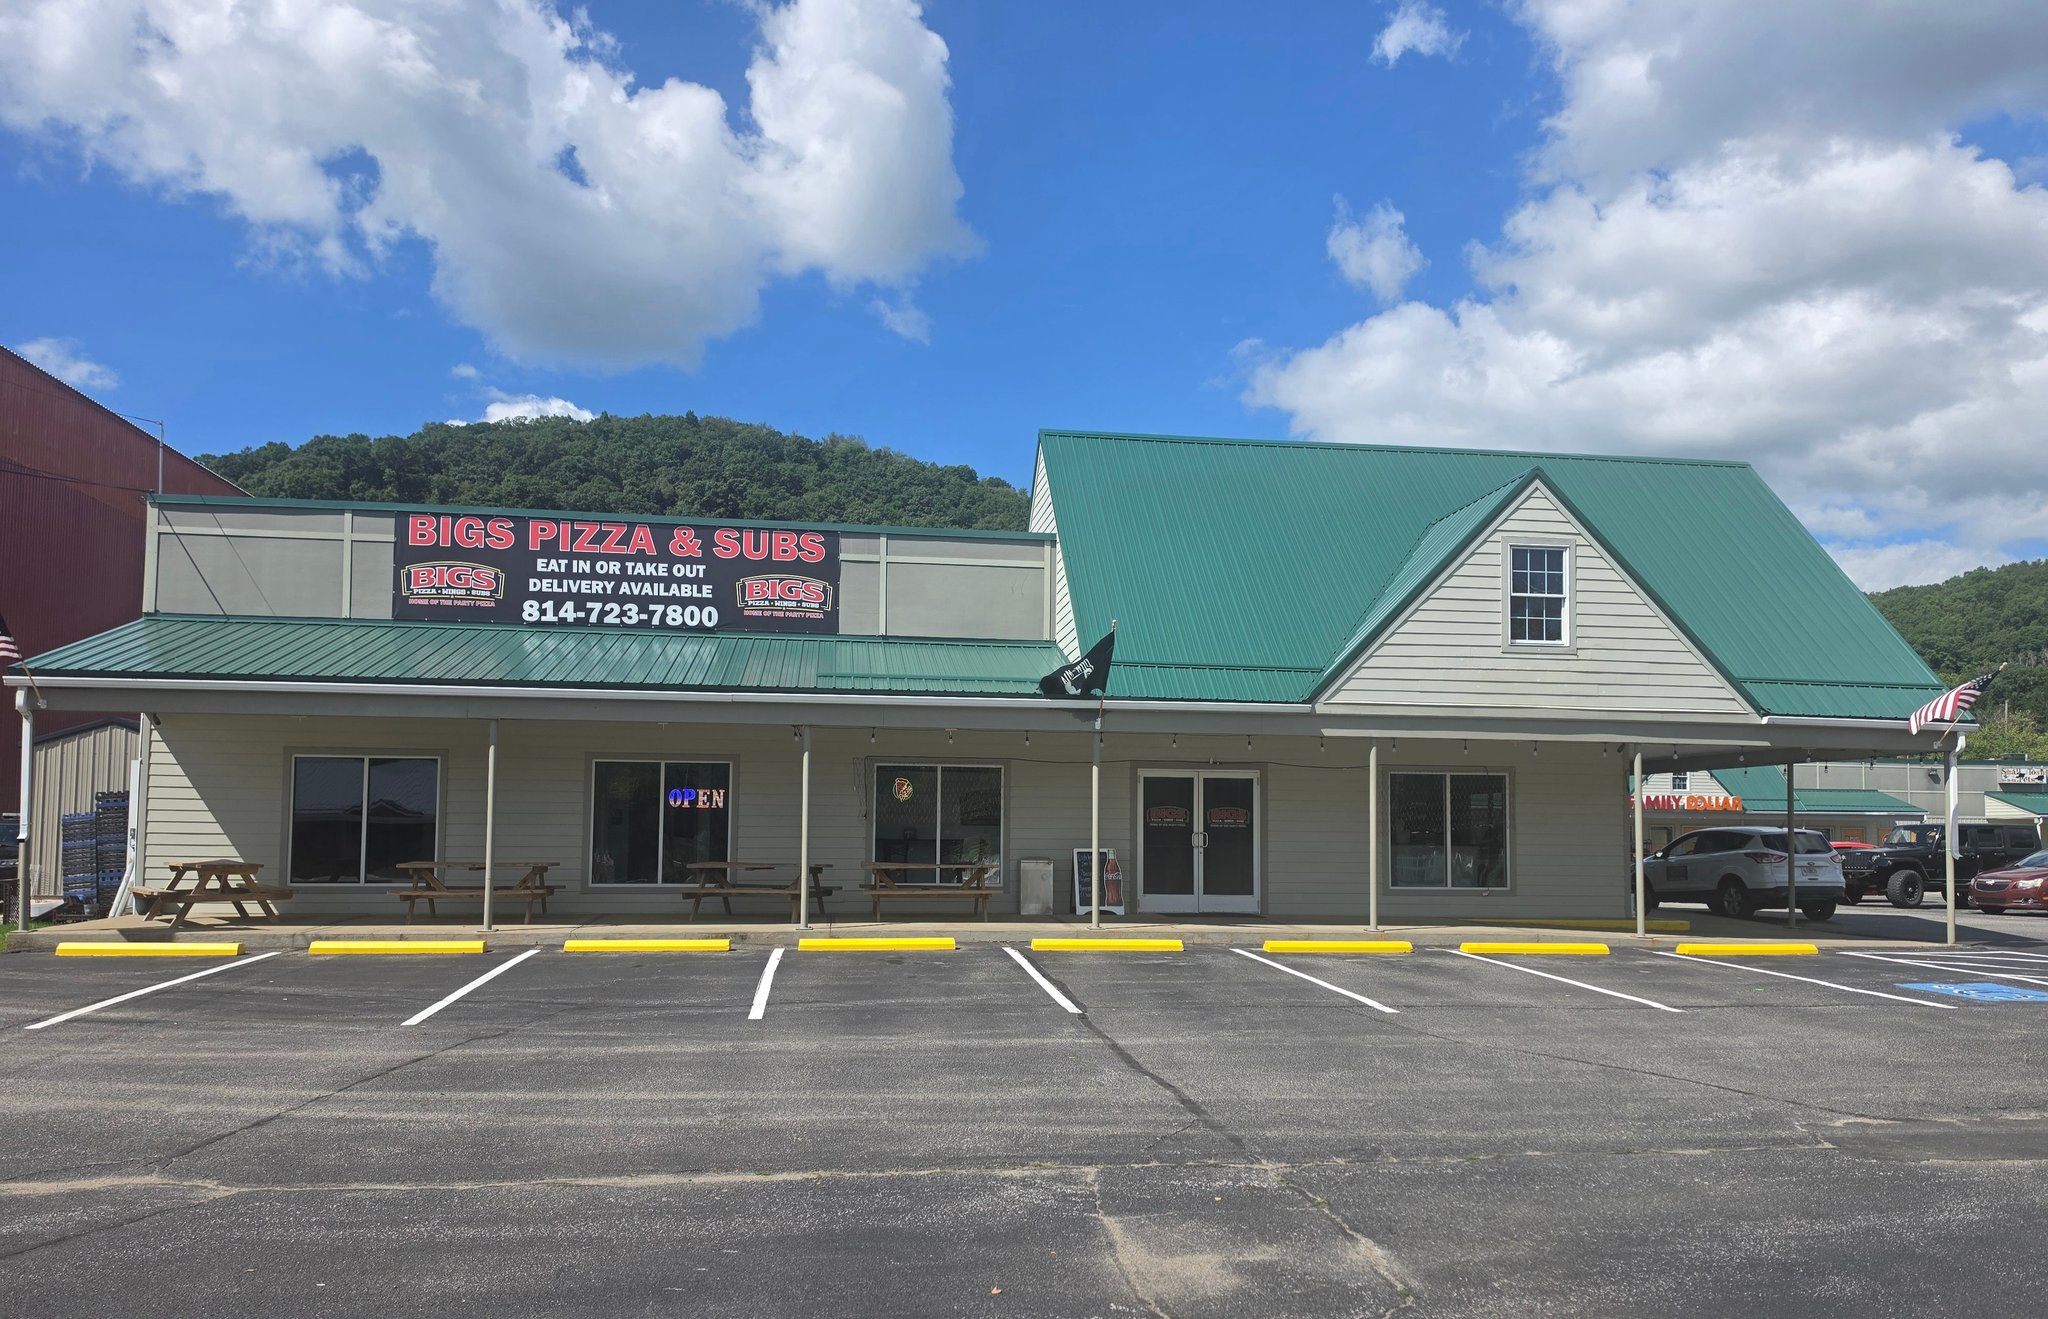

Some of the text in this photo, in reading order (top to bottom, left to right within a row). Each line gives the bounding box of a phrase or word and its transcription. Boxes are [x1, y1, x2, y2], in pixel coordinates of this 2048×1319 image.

[408, 514, 826, 562] BIGS PIZZA & SUBS
[410, 566, 497, 591] BIGS
[536, 558, 707, 578] EAT IN OR TAKE OUT
[528, 578, 713, 598] DELIVERY AVAILABLE
[745, 579, 825, 603] BIGS
[521, 599, 719, 628] 814-723-7800
[774, 600, 797, 608] WINGS
[668, 788, 725, 809] OPEN
[1686, 795, 1743, 811] DOLLAR
